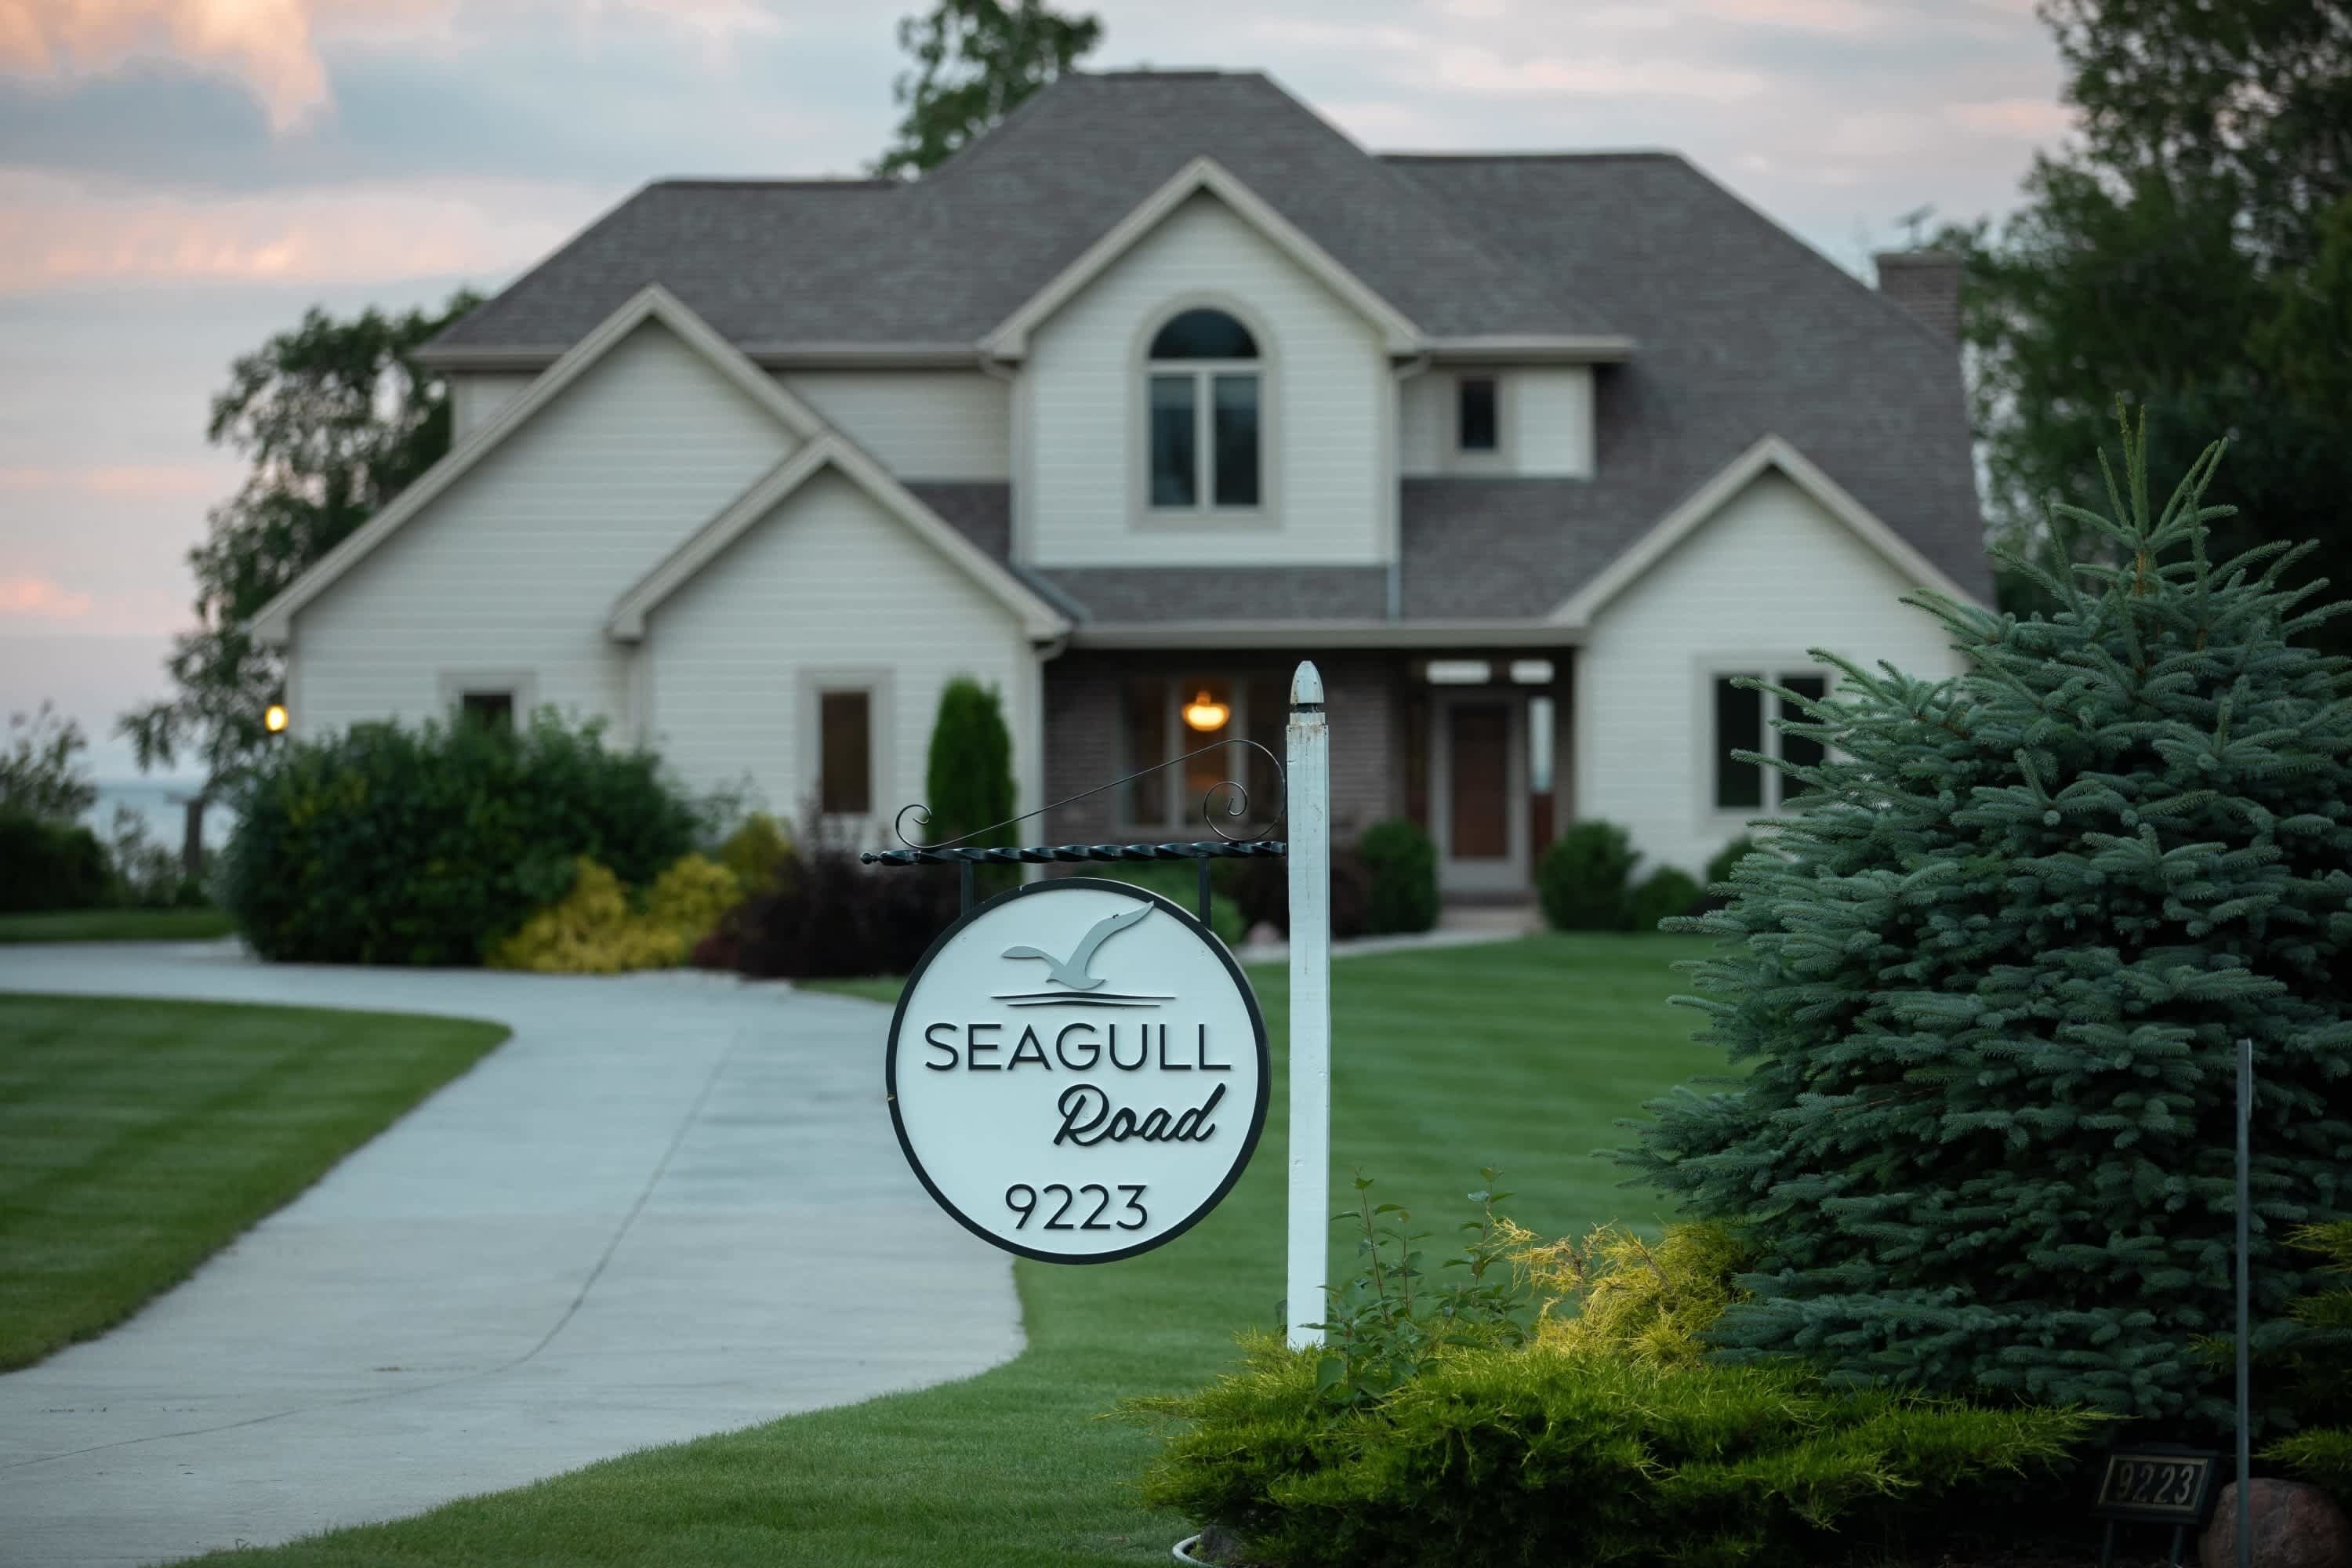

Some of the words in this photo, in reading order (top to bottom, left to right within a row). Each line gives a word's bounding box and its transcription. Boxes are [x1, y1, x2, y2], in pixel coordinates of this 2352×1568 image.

[924, 1022, 1232, 1072] SEAGULL
[1053, 1083, 1226, 1147] Road
[1004, 1184, 1149, 1230] 9223
[2118, 1461, 2194, 1504] 9223
